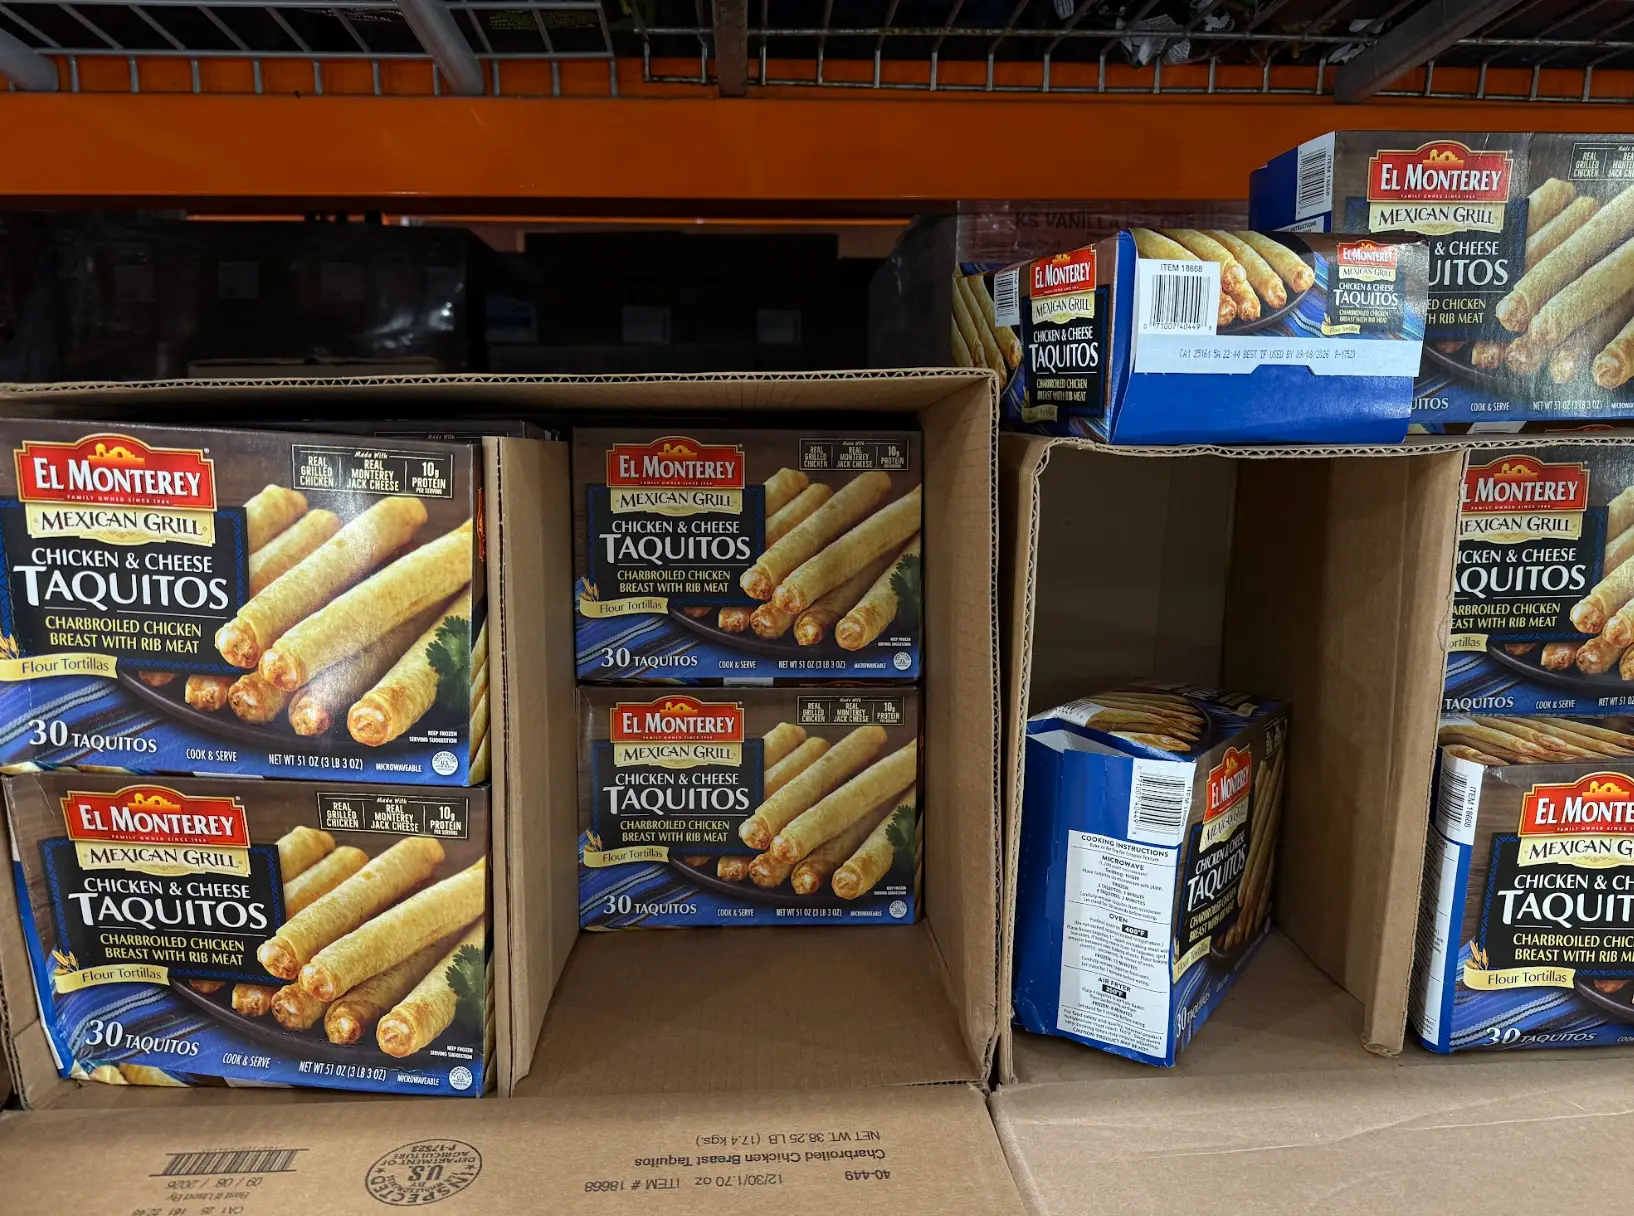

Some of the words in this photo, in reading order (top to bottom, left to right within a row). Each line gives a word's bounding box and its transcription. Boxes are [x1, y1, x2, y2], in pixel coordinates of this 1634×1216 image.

[1380, 163, 1401, 190] EL
[1404, 163, 1502, 191] MONTEREY
[1378, 206, 1450, 226] MEXICAN
[1453, 206, 1495, 225] GRILL
[1034, 266, 1044, 289] EL
[1045, 261, 1091, 287] MONTEREY
[1029, 342, 1099, 373] TAQUITOS
[1243, 349, 1257, 359] BEST
[1260, 349, 1266, 359] IF
[1270, 349, 1284, 359] USED
[1286, 349, 1293, 359] BY
[308, 456, 327, 467] REAL
[364, 459, 384, 470] REAL
[620, 455, 639, 478] EL
[643, 456, 735, 479] MONTEREY
[33, 457, 64, 490] EL
[67, 459, 201, 497] MONTEREY
[300, 465, 333, 478] GRILLED
[351, 469, 394, 481] MONTEREY
[422, 462, 440, 478] 10g
[300, 476, 334, 487] CHICKEN
[347, 478, 367, 490] JACK
[369, 480, 399, 491] CHEESE
[412, 477, 446, 489] PROTEIN
[1474, 478, 1578, 502] MONTEREY
[620, 491, 688, 508] MEXICAN
[693, 492, 734, 507] GRILL
[41, 512, 137, 531] MEXICAN
[143, 513, 203, 536] GRILL
[612, 520, 673, 533] CHICKEN
[677, 521, 688, 533] &
[691, 520, 740, 534] CHEESE
[1527, 515, 1572, 533] GRILL
[599, 534, 750, 565] TAQUITOS
[31, 548, 119, 568] CHICKEN
[125, 553, 140, 569] &
[144, 553, 213, 573] CHEESE
[13, 565, 229, 611] TAQUITOS
[600, 604, 624, 614] Flour
[626, 599, 662, 611] Tortillas
[45, 615, 140, 633] CHARBROILED
[143, 621, 201, 637] CHICKEN
[50, 632, 98, 648] BREAST
[101, 634, 136, 650] WITH
[141, 637, 162, 652] RIB
[165, 639, 200, 654] MEAT
[22, 660, 58, 674] Flour
[59, 657, 109, 671] Tortillas
[601, 647, 631, 667] 30
[633, 655, 698, 668] TAQUITOS
[622, 712, 642, 734] EL
[645, 712, 735, 734] MONTEREY
[28, 719, 68, 747] 30
[71, 733, 157, 753] TAQUITOS
[186, 748, 206, 760] COOK
[208, 750, 214, 760] &
[215, 750, 237, 762] SERVE
[624, 745, 689, 761] MEXICAN
[693, 745, 734, 760] GRILL
[268, 754, 282, 765] NET
[283, 754, 295, 766] WT
[297, 755, 306, 766] 51
[308, 755, 319, 767] OZ
[320, 756, 329, 769] (3
[331, 757, 340, 768] LB
[342, 758, 348, 768] 3
[350, 757, 363, 770] OZ)
[376, 763, 422, 773] MICROWAVEABLE
[615, 773, 674, 785] CHICKEN
[679, 774, 688, 785] &
[692, 773, 739, 785] CHEESE
[1211, 781, 1219, 809] EL
[1220, 764, 1250, 802] MONTEREY
[602, 786, 750, 815] TAQUITOS
[1467, 786, 1476, 805] ITEM
[1535, 797, 1558, 825] EL
[1561, 797, 1634, 824] MONTE
[78, 804, 108, 831] EL
[110, 806, 233, 836] MONTEREY
[1081, 835, 1114, 847] COOKING
[1115, 841, 1169, 857] INSTRUCTIONS
[1529, 839, 1612, 859] MEXICAN
[90, 848, 177, 864] MEXICAN
[183, 849, 238, 868] GRILL
[602, 852, 627, 862] Flour
[629, 848, 663, 859] Tortillas
[1102, 855, 1144, 870] MICROWAVE
[84, 877, 162, 895] CHICKEN
[169, 881, 182, 896] &
[187, 882, 251, 899] CHEESE
[68, 892, 268, 930] TAQUITOS
[603, 894, 631, 914] 30
[634, 903, 697, 916] TAQUITOS
[1109, 913, 1128, 923] OVEN
[82, 969, 114, 982] Flour
[119, 966, 161, 979] Tortillas
[1487, 974, 1519, 985] Flour
[1522, 970, 1567, 983] Tortillas
[1098, 977, 1109, 985] AIR
[1110, 980, 1131, 992] FRYER
[85, 1019, 123, 1047] 30
[125, 1034, 199, 1056] TAQUITOS
[1481, 1028, 1521, 1046] 30
[1520, 1033, 1597, 1043] TAQUITOS
[222, 1052, 241, 1065] COOK
[242, 1056, 248, 1066] &
[250, 1056, 271, 1069] SERVE
[696, 1134, 729, 1147] kgs.)
[731, 1133, 761, 1146] (17.4
[769, 1134, 785, 1144] LB
[789, 1132, 825, 1143] 38.25
[855, 1130, 880, 1141] NET
[393, 1151, 470, 1160] AGRICULTURE
[411, 1144, 456, 1152] P-17523
[805, 1149, 886, 1161] Charbroiled
[399, 1157, 476, 1166] DEPARTMENT
[634, 1155, 693, 1167] Taquitos
[696, 1153, 741, 1165] Breast
[744, 1151, 801, 1163] Chicken
[408, 1164, 444, 1180] U.S.
[715, 1173, 784, 1187] 12/30/1.70
[845, 1169, 891, 1181] 40-449
[370, 1172, 474, 1203] INSPECTED
[584, 1180, 625, 1192] 18668
[630, 1178, 641, 1190] #
[645, 1178, 680, 1190] ITEM
[694, 1177, 712, 1186] oz
